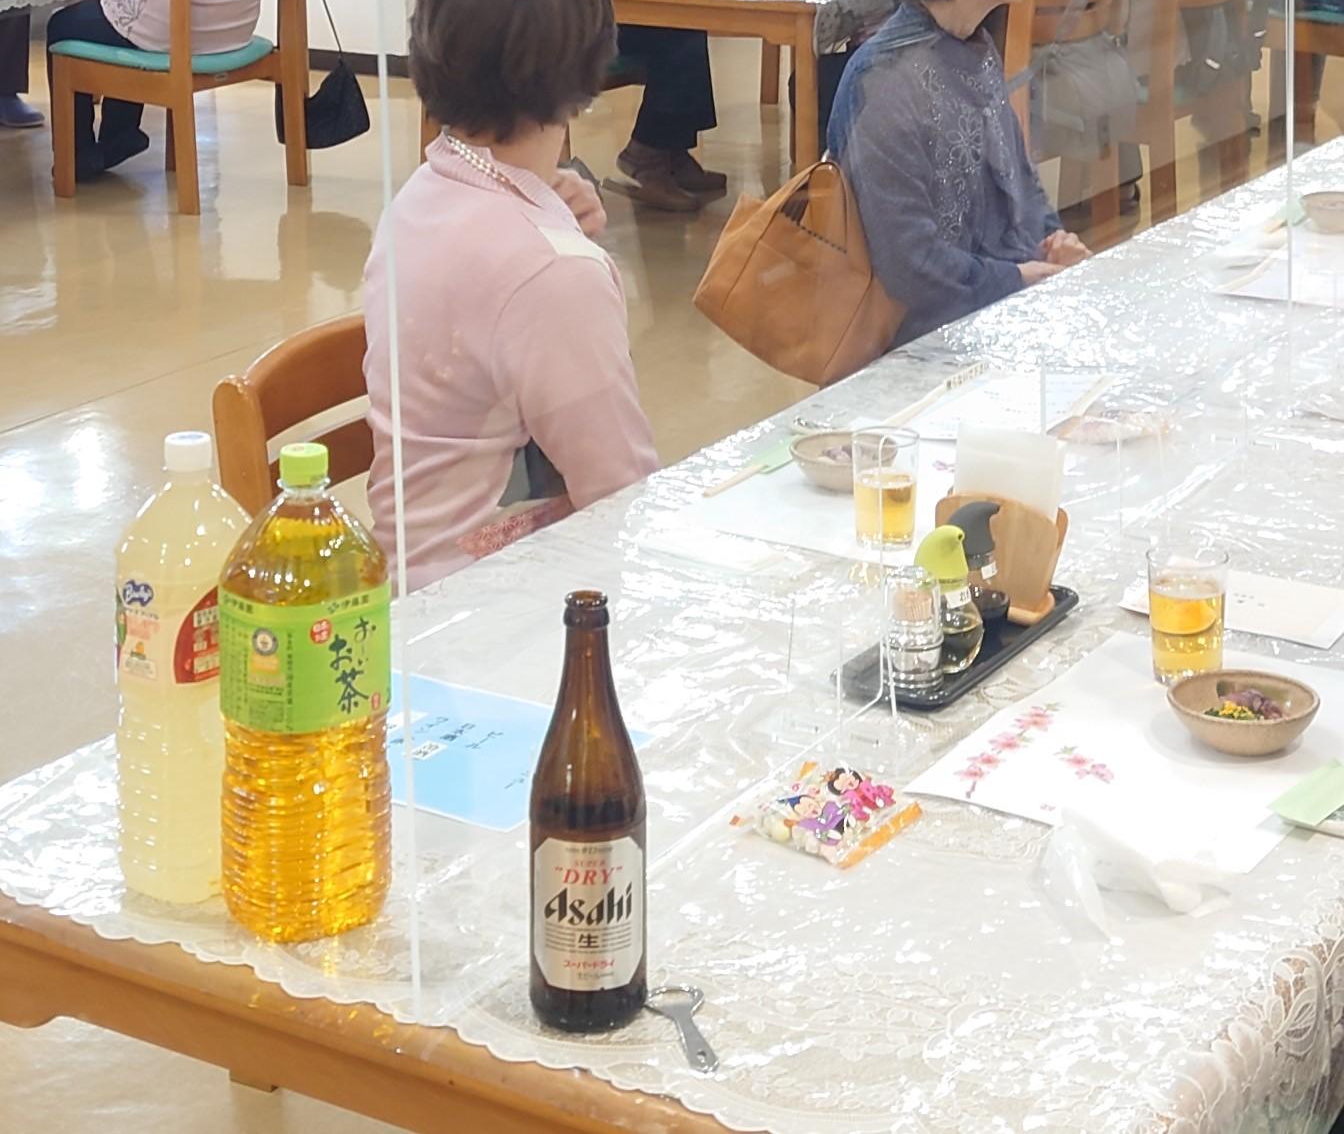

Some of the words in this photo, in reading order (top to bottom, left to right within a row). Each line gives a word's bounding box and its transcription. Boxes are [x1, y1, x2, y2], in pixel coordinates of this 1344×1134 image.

[329, 634, 369, 714] お茶
[544, 882, 632, 926] Asahi
[578, 933, 599, 948] 生
